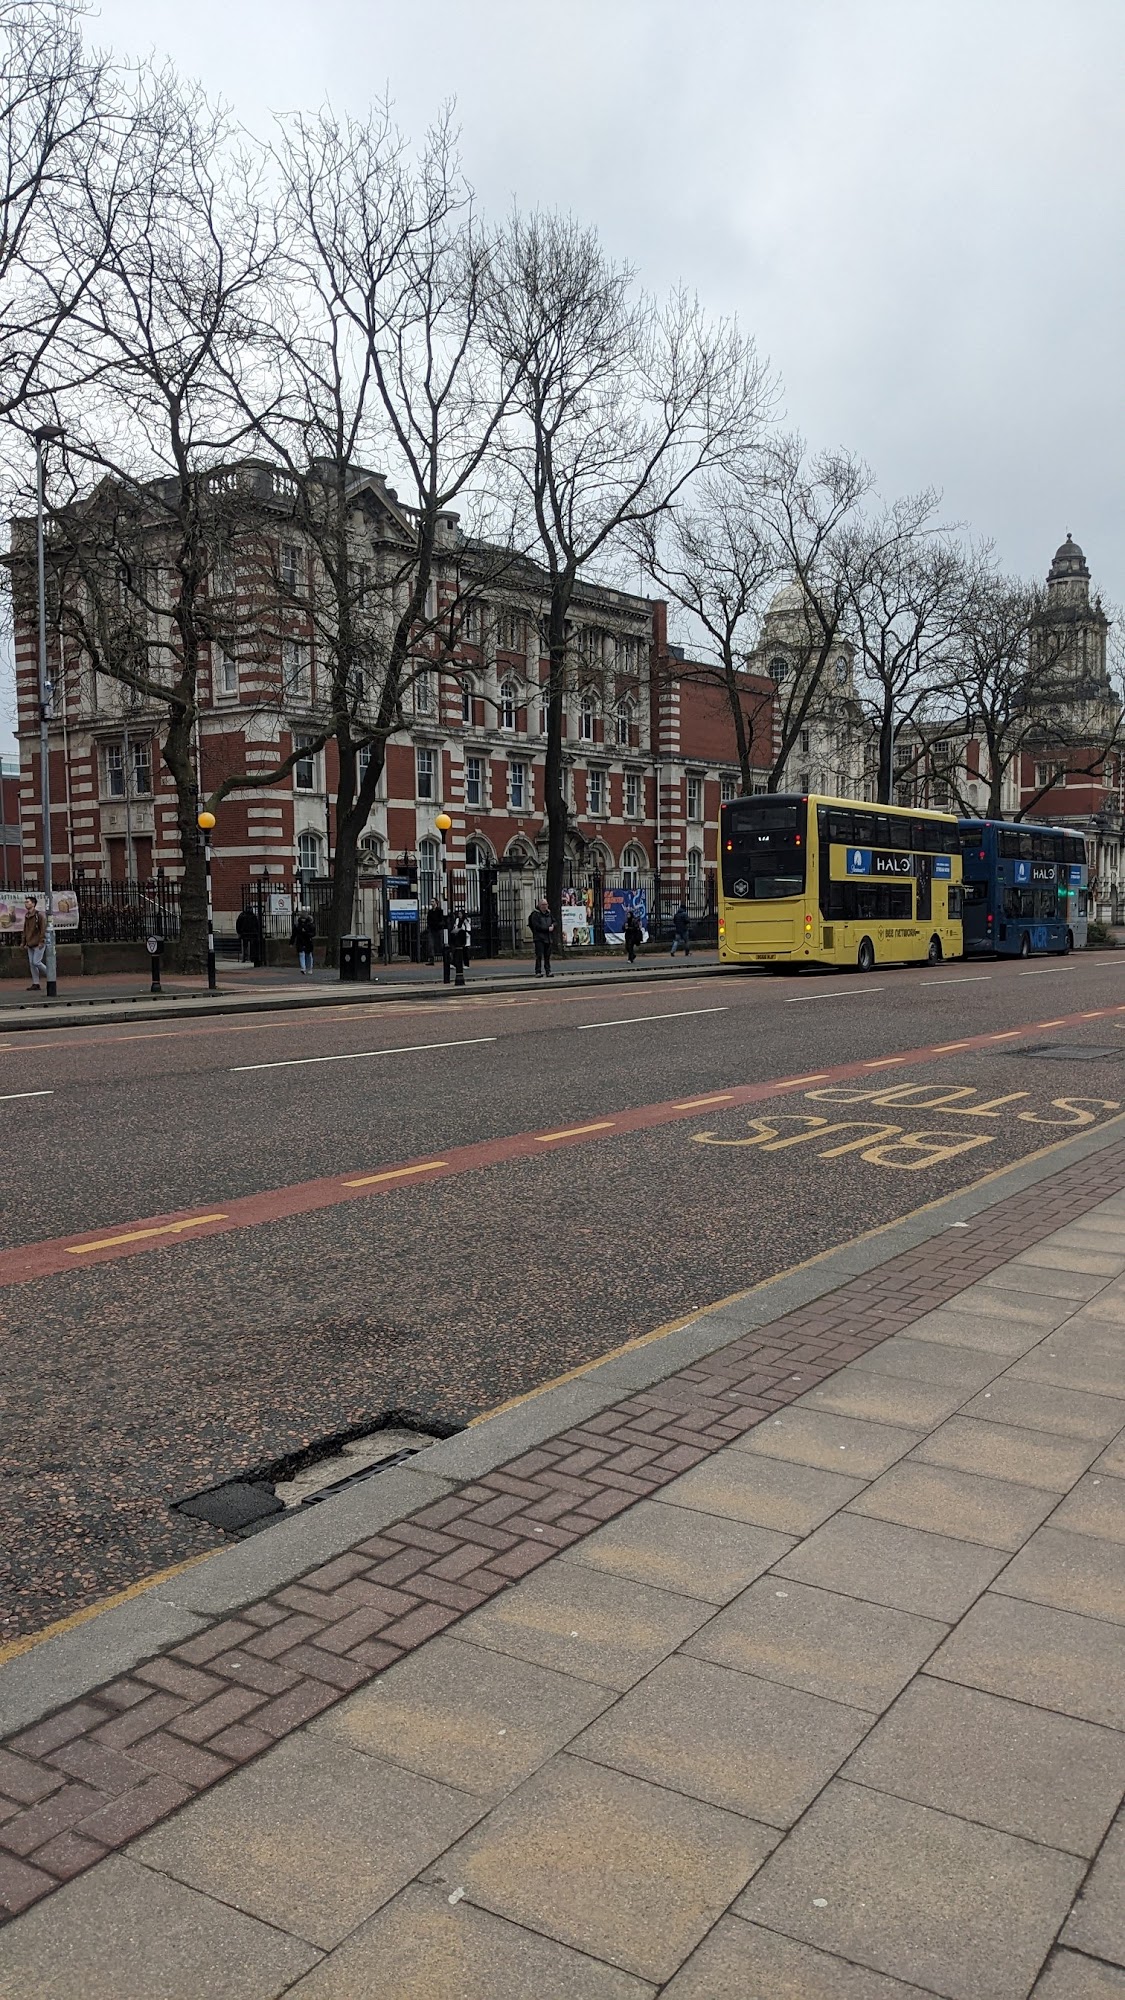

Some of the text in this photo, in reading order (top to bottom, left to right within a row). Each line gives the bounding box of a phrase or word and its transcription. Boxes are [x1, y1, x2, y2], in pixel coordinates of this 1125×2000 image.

[877, 857, 911, 872] HALO
[1033, 868, 1055, 880] HALO
[804, 1082, 1120, 1126] STOP
[688, 1115, 999, 1170] BUS
